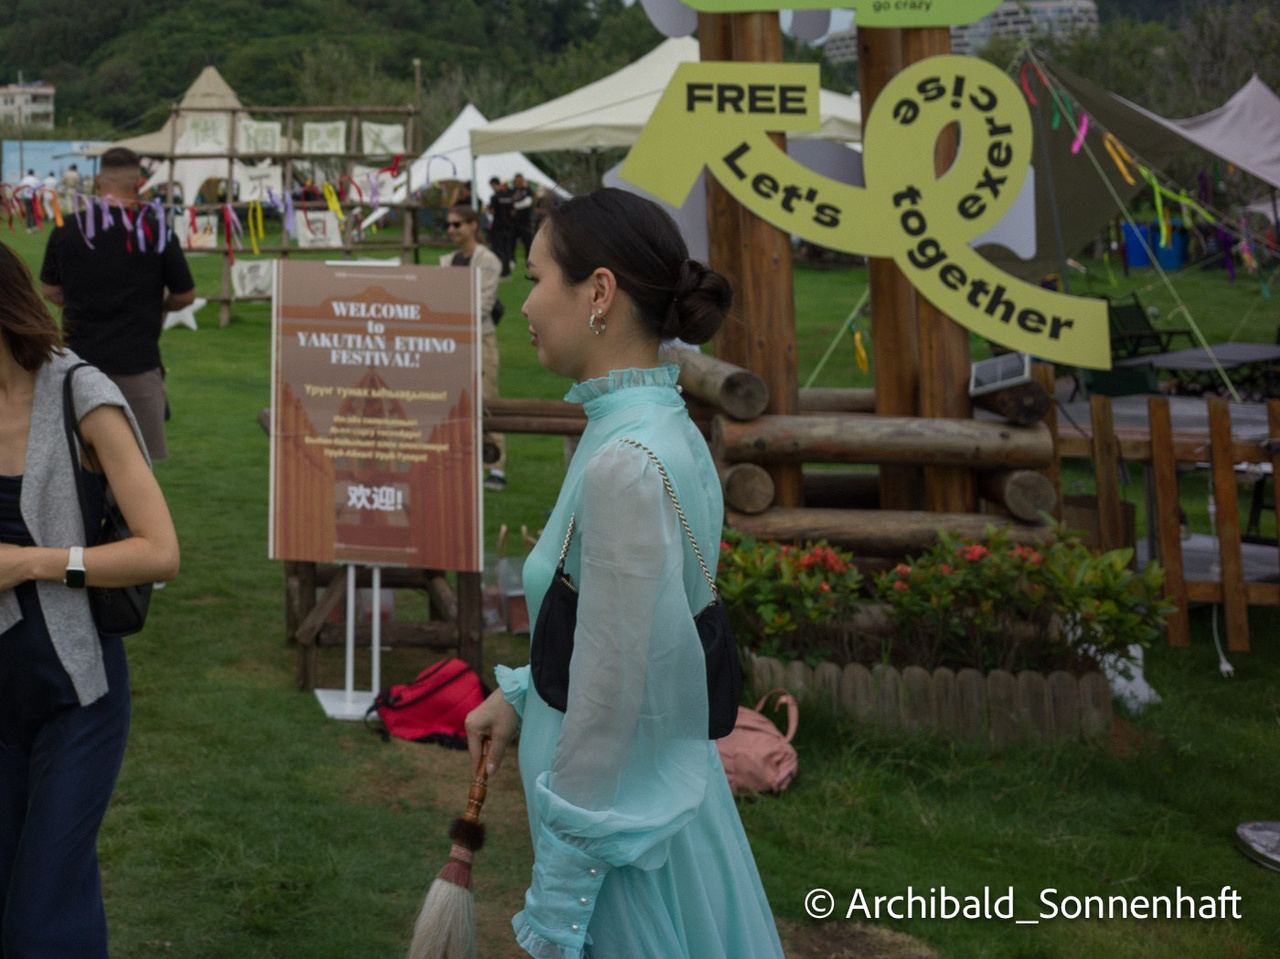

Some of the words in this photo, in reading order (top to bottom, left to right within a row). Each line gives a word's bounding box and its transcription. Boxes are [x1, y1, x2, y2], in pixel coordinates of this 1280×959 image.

[873, 0, 891, 13] go
[894, 0, 933, 12] crazy
[685, 82, 808, 115] FREE
[722, 141, 842, 229] Let's
[892, 184, 1075, 340] together
[331, 300, 421, 320] WELCOME
[367, 320, 385, 334] to
[297, 330, 386, 350] YAKUTIAN
[394, 336, 457, 355] ETHNO
[330, 348, 421, 368] FESTIVAL!
[347, 484, 403, 510] 欢迎!
